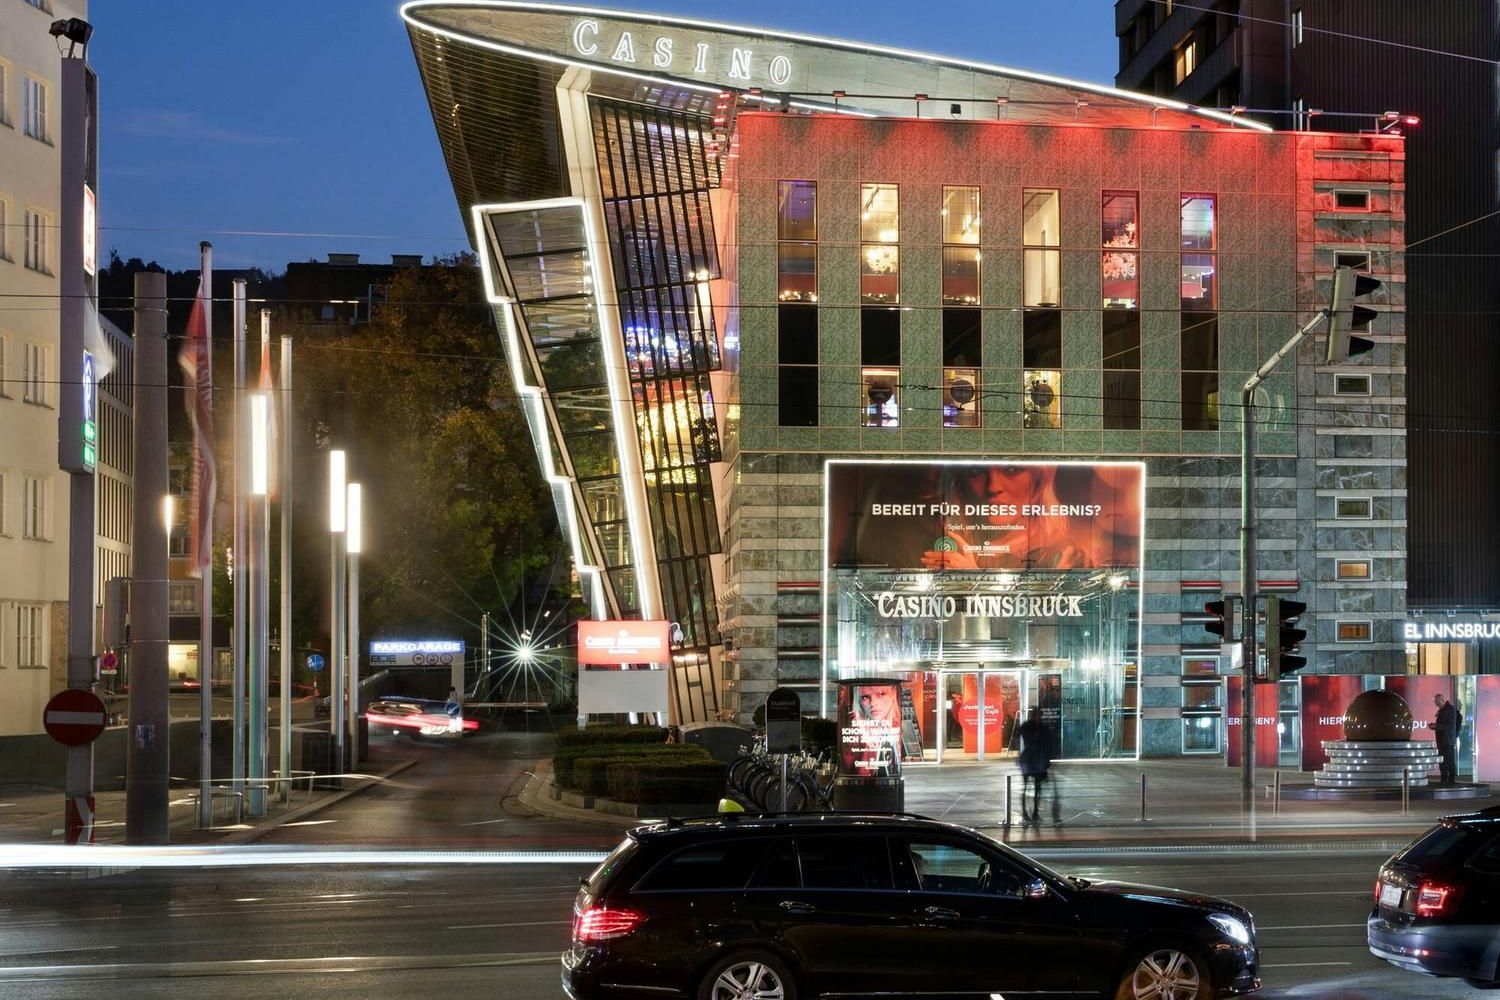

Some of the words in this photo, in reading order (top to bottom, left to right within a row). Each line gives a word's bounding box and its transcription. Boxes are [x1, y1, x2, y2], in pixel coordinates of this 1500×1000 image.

[572, 20, 793, 85] CASINO
[872, 504, 926, 516] BEREIT
[930, 502, 961, 516] FÜR
[964, 504, 1018, 516] DIESES
[1021, 504, 1102, 516] ERLEBNIS?
[877, 591, 956, 618] CASINO
[964, 594, 1084, 618] INNSBRUCK
[373, 642, 461, 652] PARKGARAGE
[1318, 716, 1344, 726] HIER
[1412, 720, 1428, 730] DU
